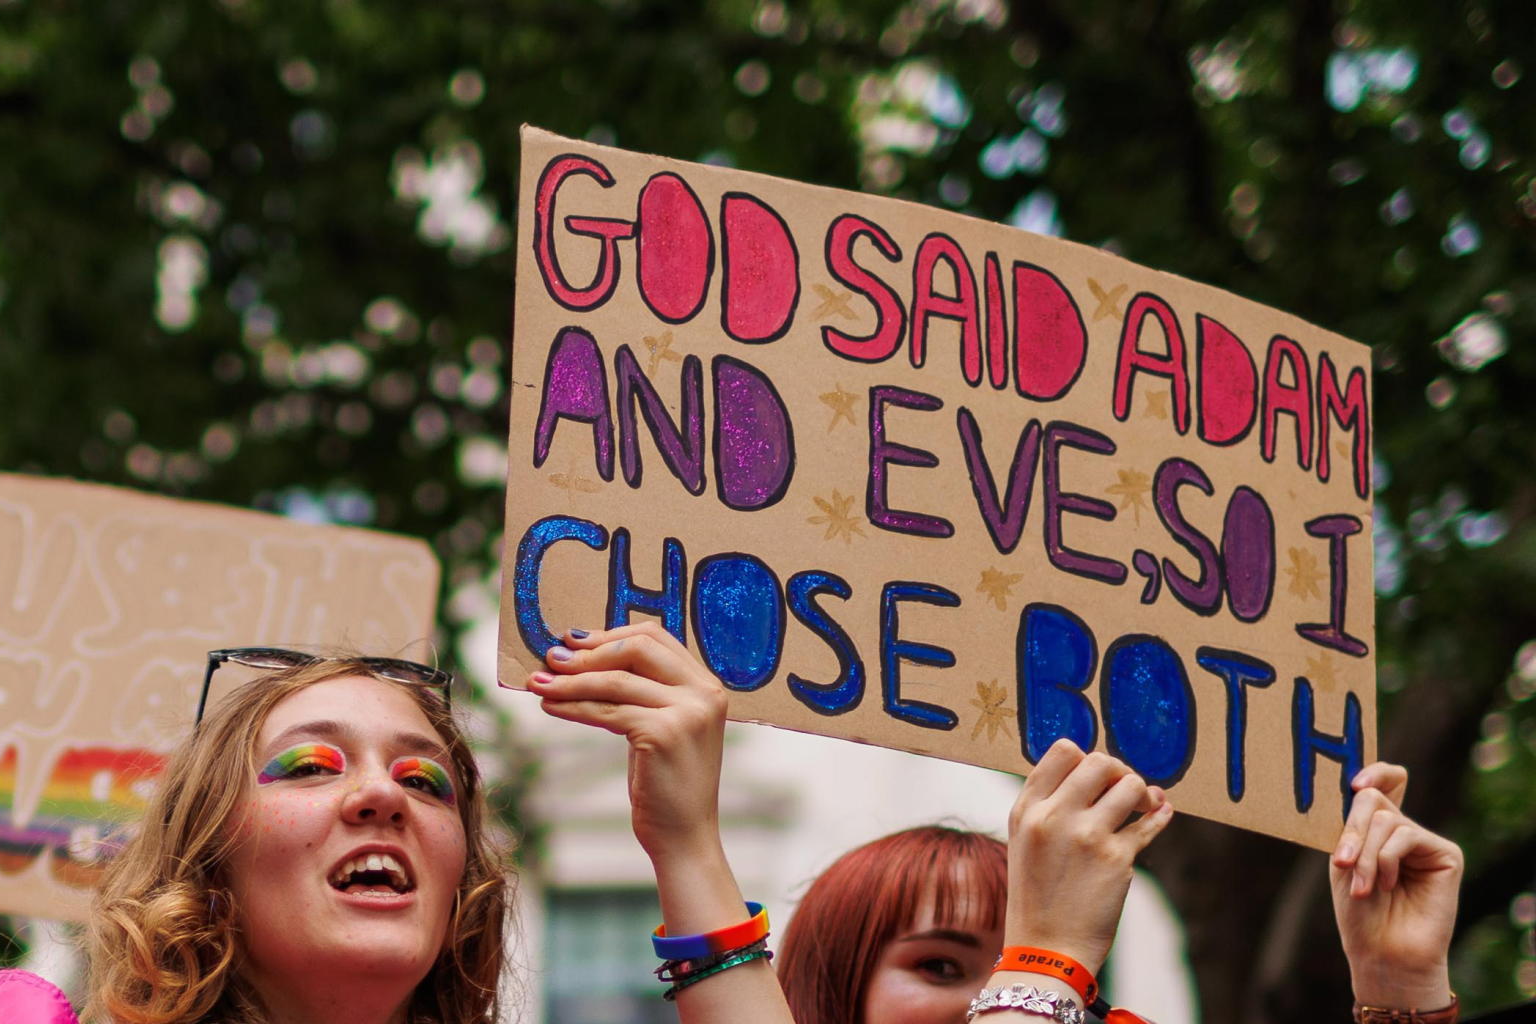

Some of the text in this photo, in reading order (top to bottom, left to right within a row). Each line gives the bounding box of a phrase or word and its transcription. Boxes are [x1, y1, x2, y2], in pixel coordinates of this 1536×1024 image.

[533, 154, 1369, 499] GOD SAID ADAM
[532, 326, 796, 511] AND
[1153, 457, 1276, 622] SO
[1295, 513, 1368, 657] I
[513, 514, 960, 729] CHOSE
[1016, 602, 1365, 818] BOTH
[1018, 952, 1075, 977] Parade
